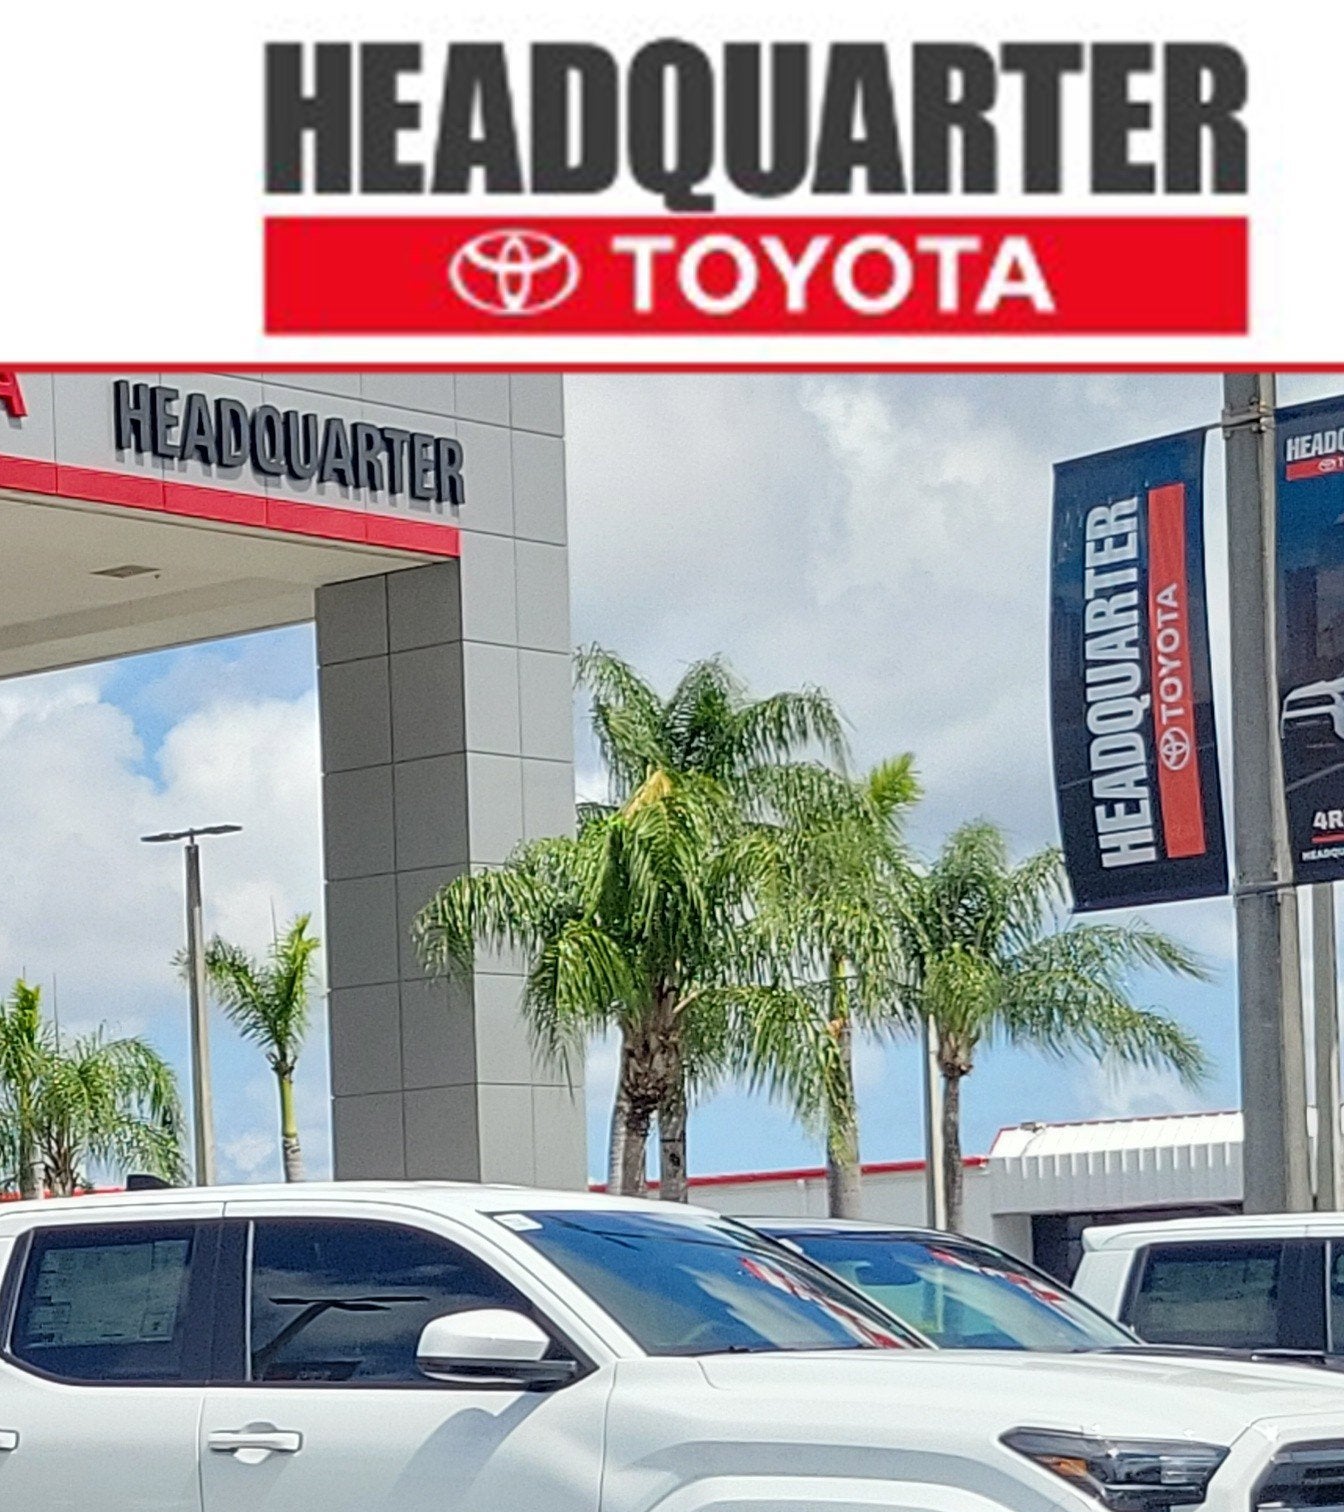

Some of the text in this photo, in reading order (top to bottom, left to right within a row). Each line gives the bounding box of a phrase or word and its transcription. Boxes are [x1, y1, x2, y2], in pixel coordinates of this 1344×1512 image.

[113, 380, 467, 506] HEADQUARTER
[1083, 495, 1158, 869] HEADQUARTER
[1157, 582, 1187, 726] TOYOTA
